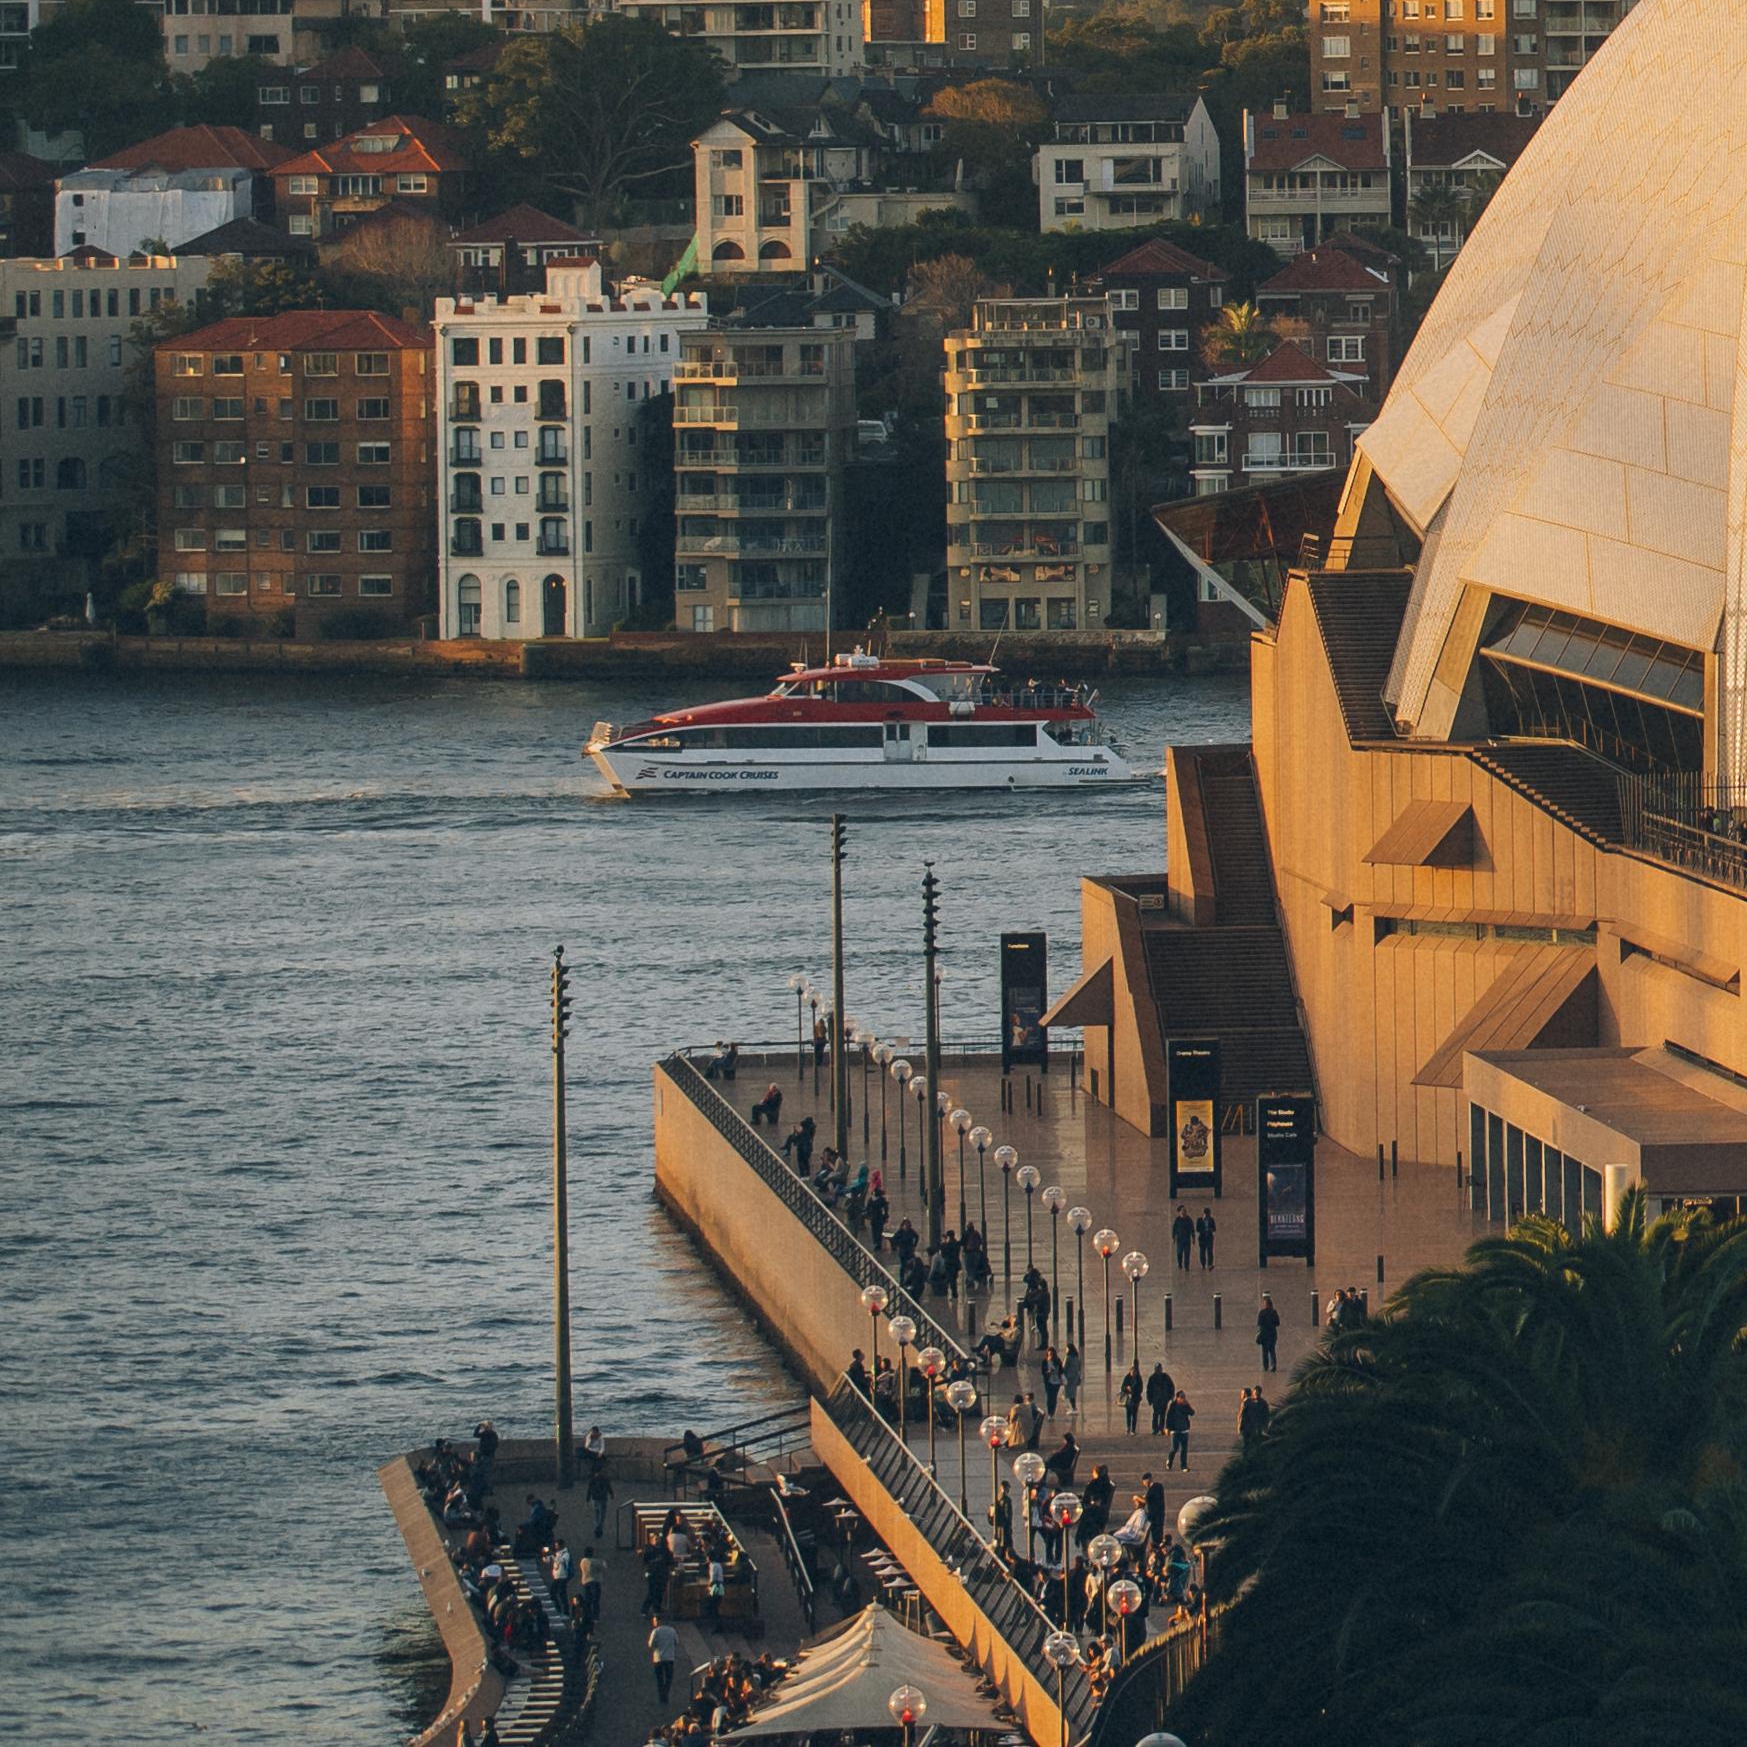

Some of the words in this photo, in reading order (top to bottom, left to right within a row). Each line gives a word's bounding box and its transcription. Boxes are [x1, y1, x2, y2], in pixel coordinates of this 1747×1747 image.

[664, 770, 708, 779] CAPTAIN
[709, 771, 739, 779] COOK
[740, 770, 779, 780] CRUISES
[1068, 767, 1109, 775] SEALINK
